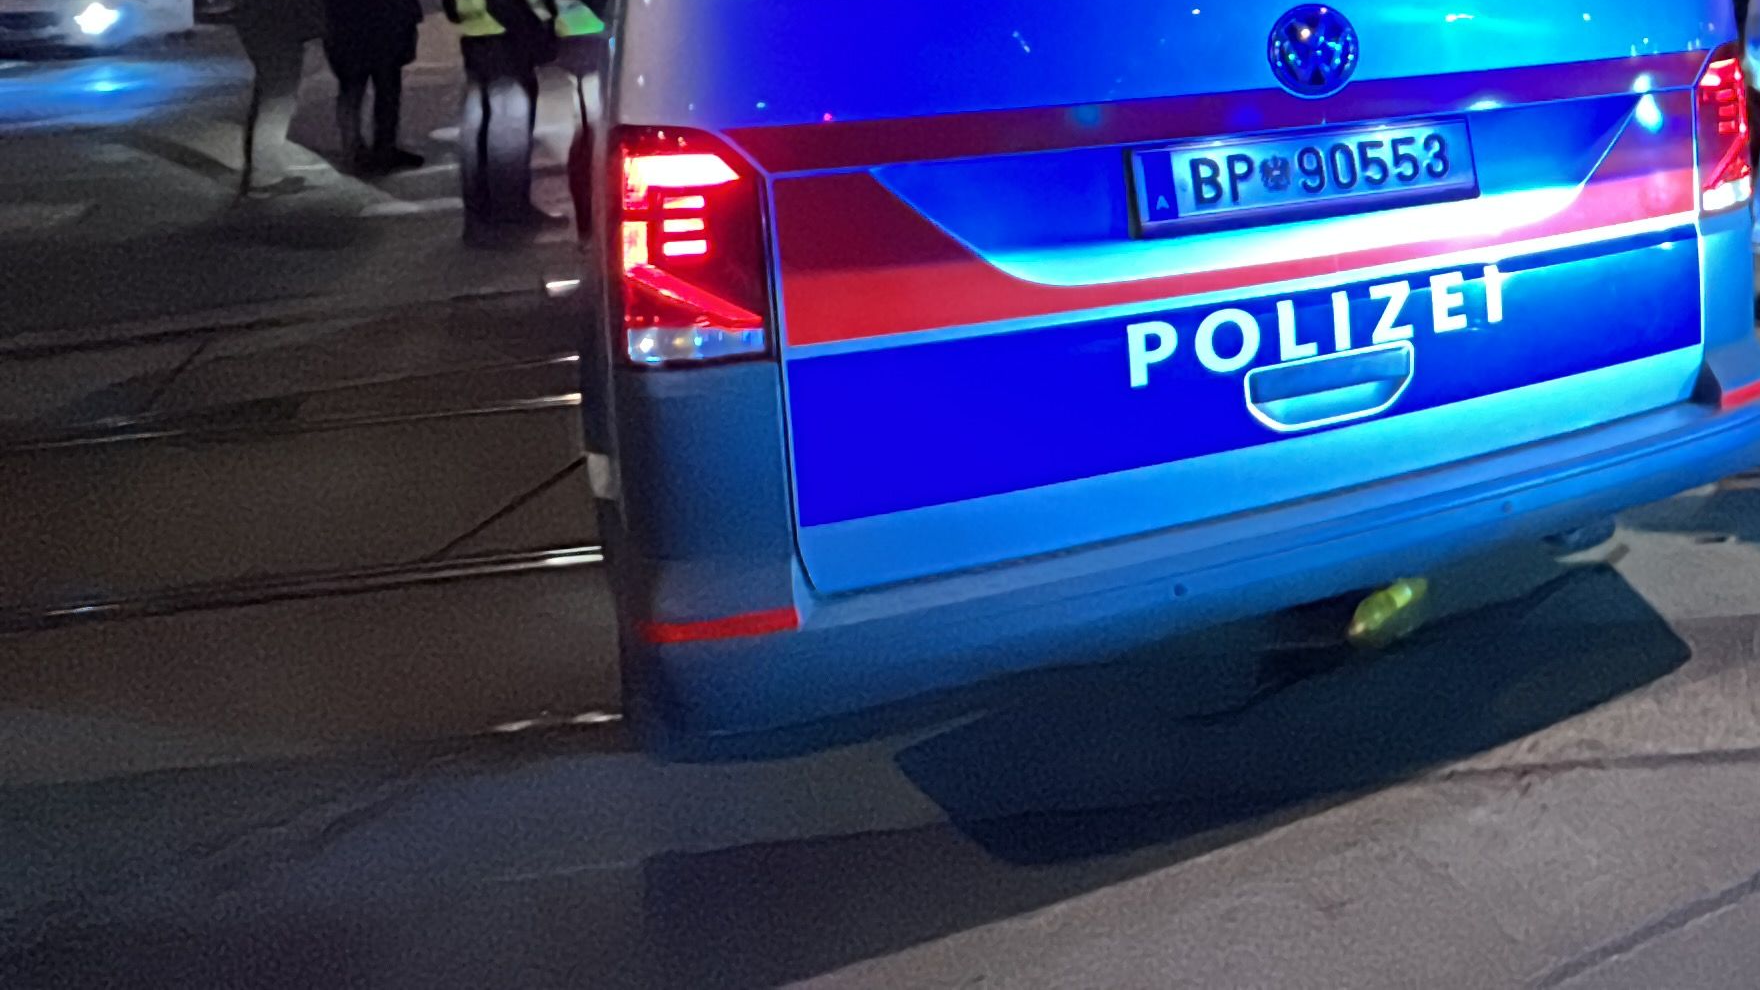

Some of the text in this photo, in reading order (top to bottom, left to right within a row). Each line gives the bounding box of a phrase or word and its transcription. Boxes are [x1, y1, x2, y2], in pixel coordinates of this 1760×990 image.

[1190, 153, 1254, 205] BP
[1297, 134, 1450, 194] 90553
[1127, 265, 1503, 388] POLIZEI
